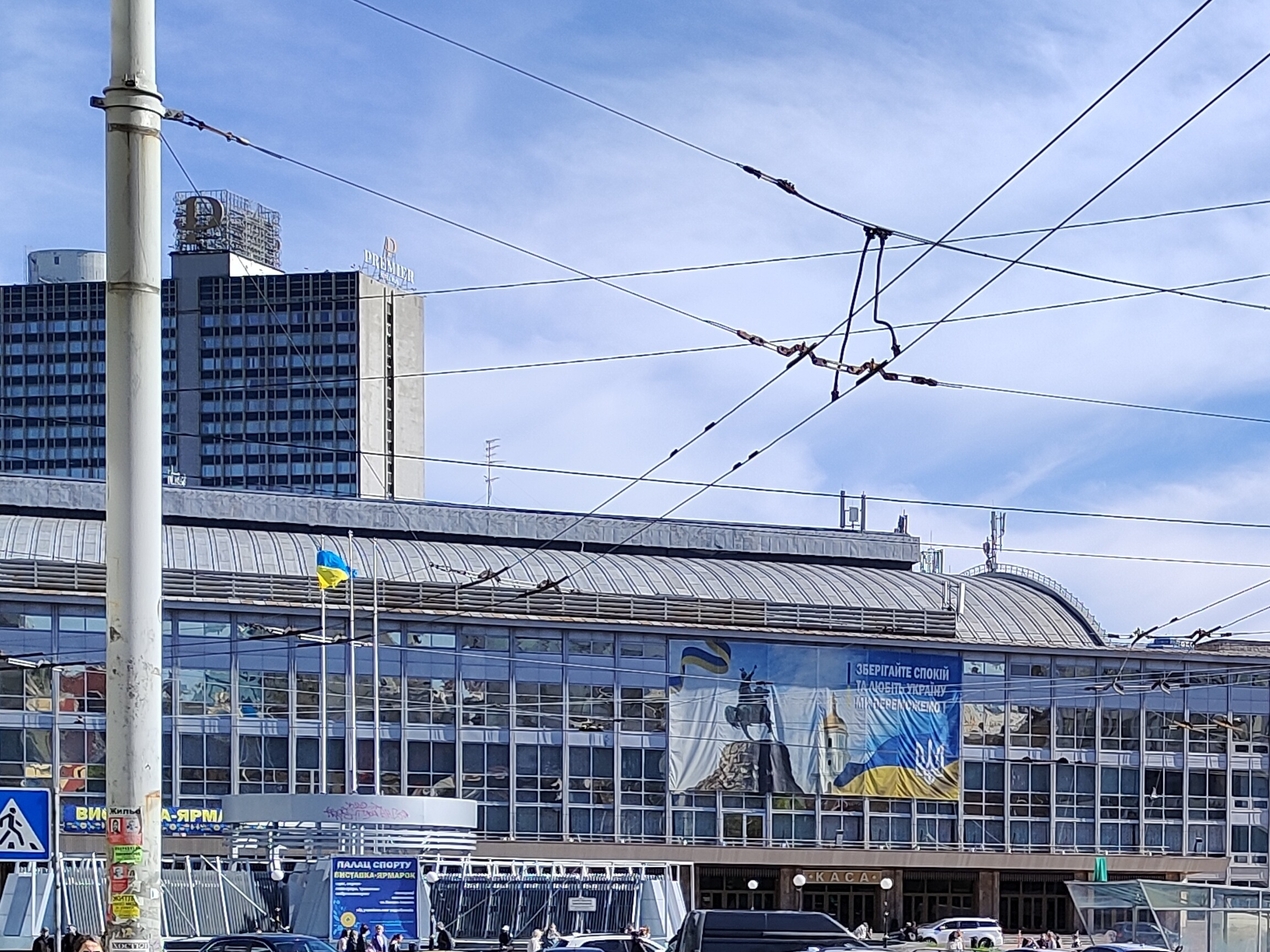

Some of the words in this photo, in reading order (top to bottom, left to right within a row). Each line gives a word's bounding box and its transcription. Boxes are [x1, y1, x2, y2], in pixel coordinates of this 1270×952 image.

[363, 248, 415, 285] PREMIER
[856, 662, 912, 679] ЗБЕРІГАЙТЕ
[913, 665, 950, 681] СПОКІЙ
[905, 681, 947, 697] УКРАЇНУ
[336, 860, 372, 869] ПАЛАЦ
[372, 861, 412, 869] СПОРТУ
[815, 871, 870, 883] КАСА
